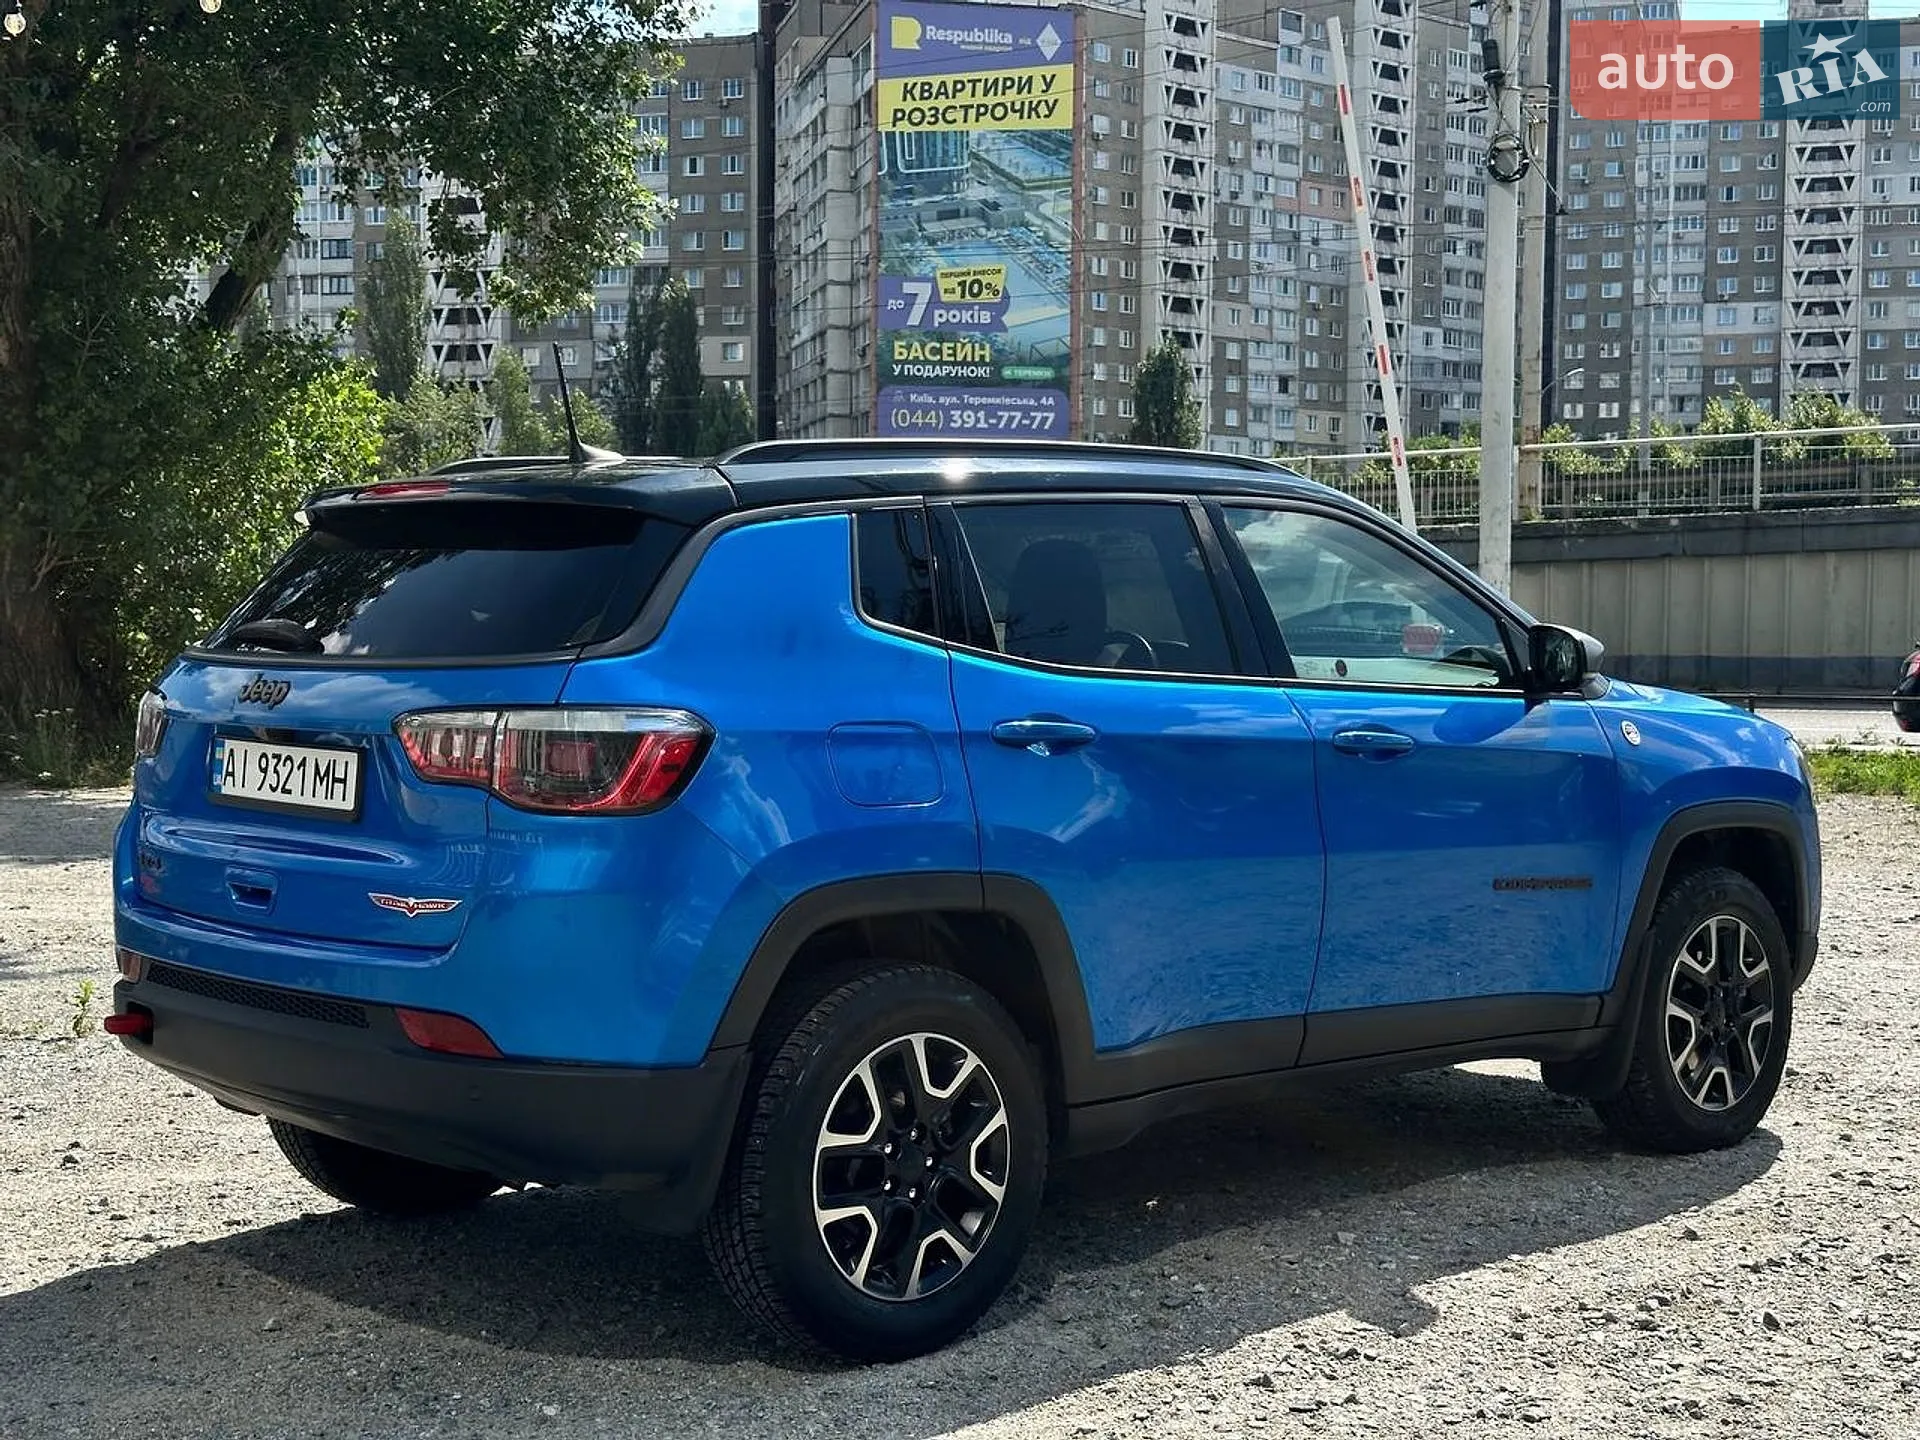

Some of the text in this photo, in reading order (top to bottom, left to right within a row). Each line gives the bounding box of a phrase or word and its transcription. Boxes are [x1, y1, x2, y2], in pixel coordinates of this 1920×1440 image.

[926, 25, 1013, 44] Respublika
[902, 74, 1057, 102] КВАРТИРИ У
[892, 98, 1059, 128] РОЗСТРОЧКУ
[957, 278, 1000, 299] 10%
[887, 299, 904, 311] до
[902, 282, 932, 326] 7
[893, 338, 990, 362] БАСЕЙН
[892, 364, 902, 377] У
[891, 408, 1055, 430] (044) 391-77-77
[239, 672, 291, 710] Jeep
[222, 748, 349, 802] AI 9321 MH
